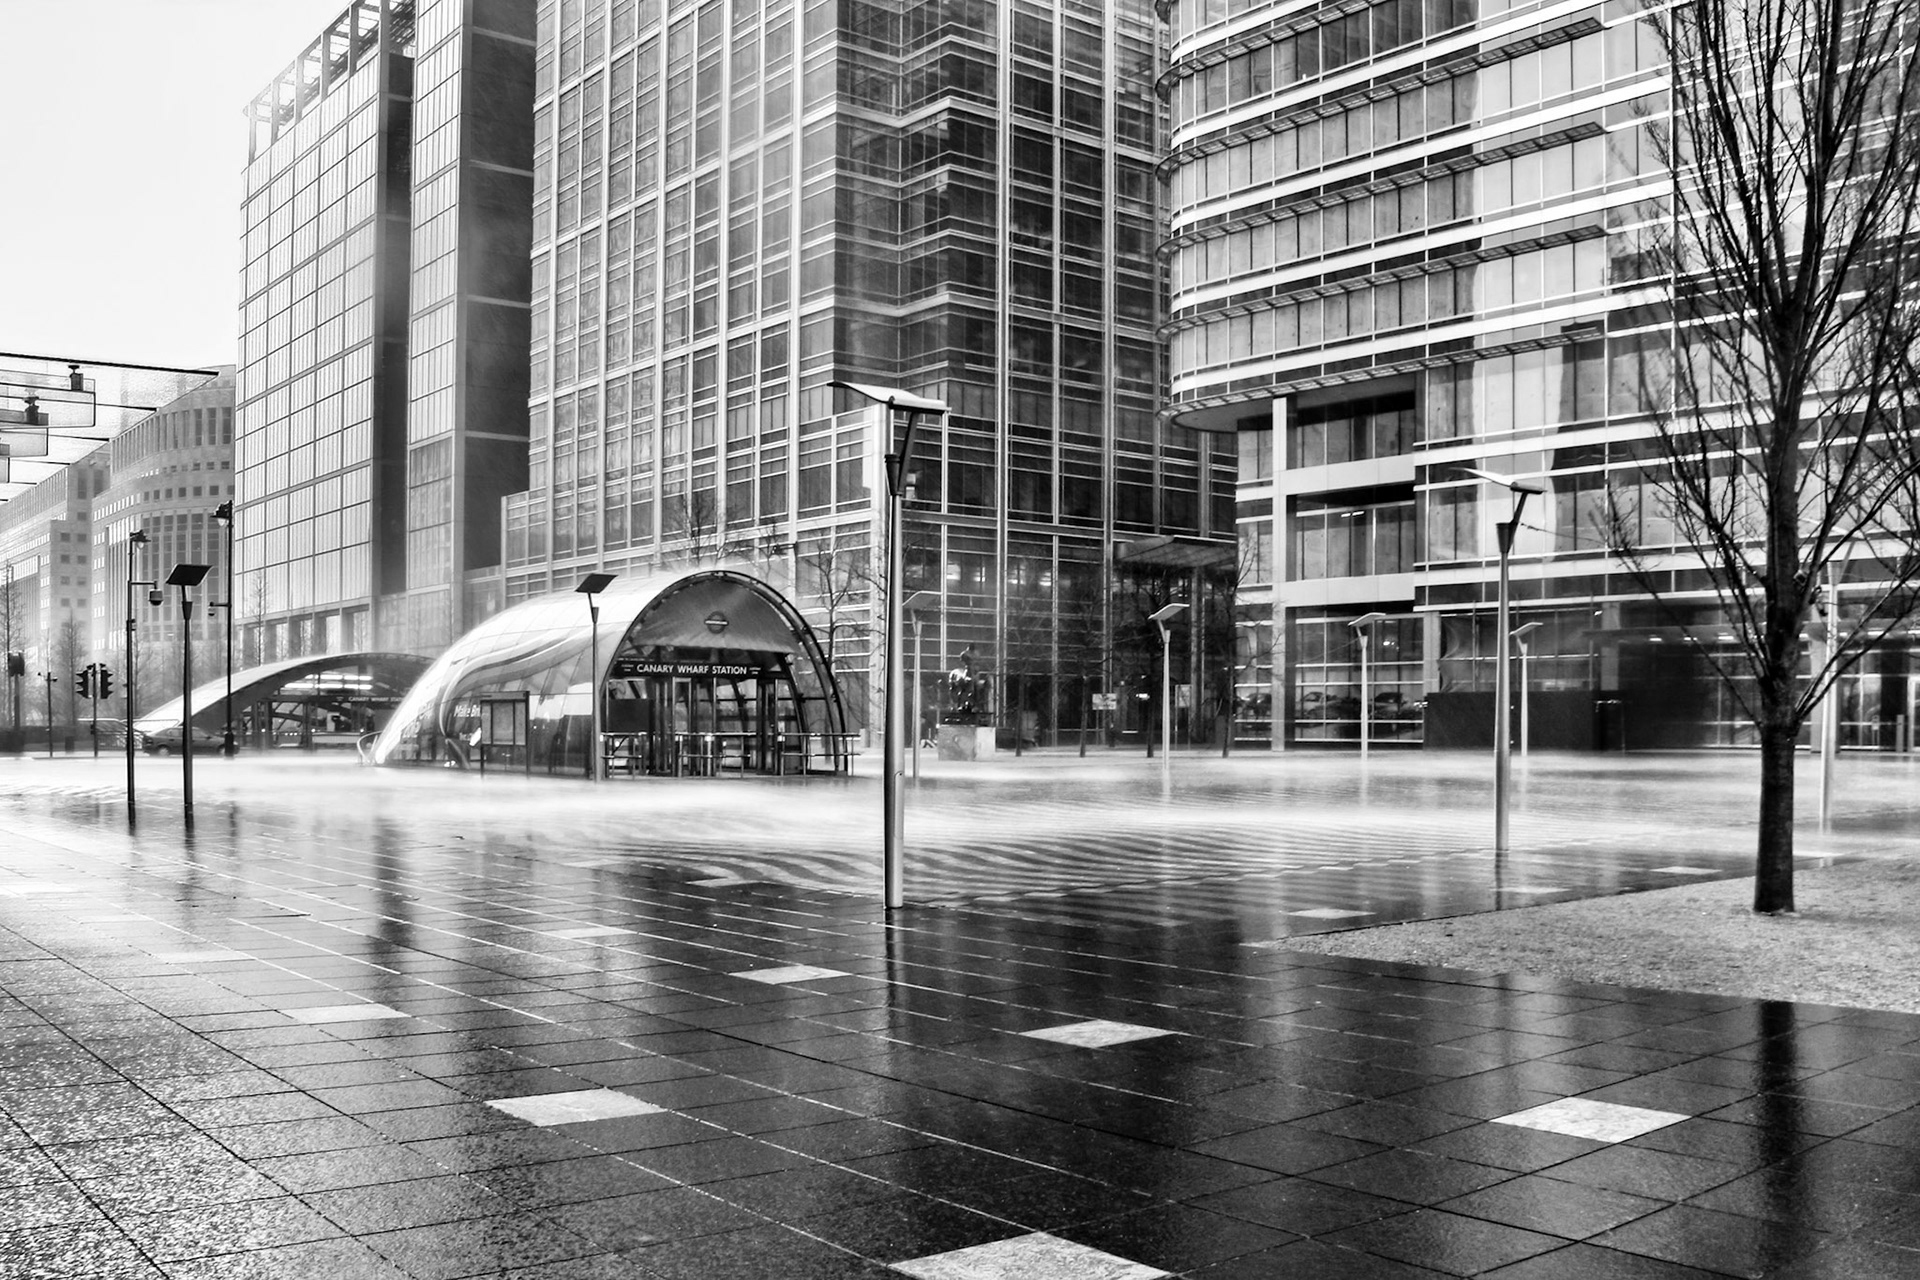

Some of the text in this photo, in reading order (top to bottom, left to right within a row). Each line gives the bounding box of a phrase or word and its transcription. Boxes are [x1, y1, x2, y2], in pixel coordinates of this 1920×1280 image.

[637, 664, 673, 673] CANARY
[677, 665, 709, 674] WHARF
[712, 666, 747, 674] STATION
